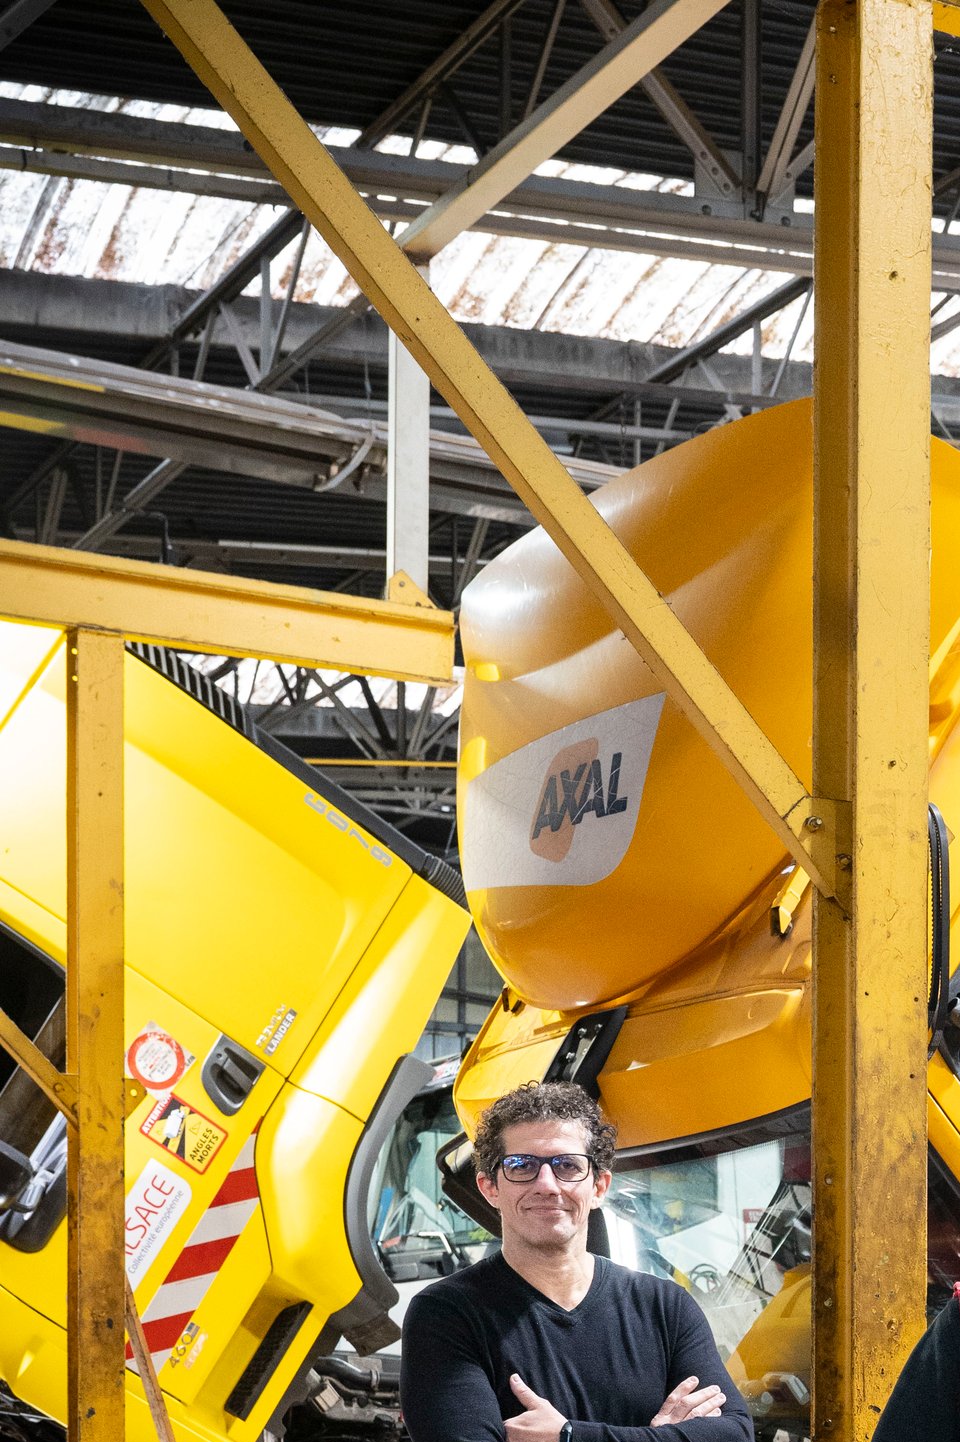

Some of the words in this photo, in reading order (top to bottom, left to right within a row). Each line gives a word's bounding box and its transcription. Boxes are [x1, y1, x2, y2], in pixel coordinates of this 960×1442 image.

[532, 752, 628, 840] AXAL
[267, 1012, 295, 1052] LANDER
[189, 1128, 213, 1160] ANGLES
[197, 1135, 219, 1164] MORTS
[125, 1174, 175, 1256] LSACE
[128, 1231, 158, 1274] Collectivité
[155, 1189, 184, 1234] européenne
[169, 1332, 193, 1369] 460
